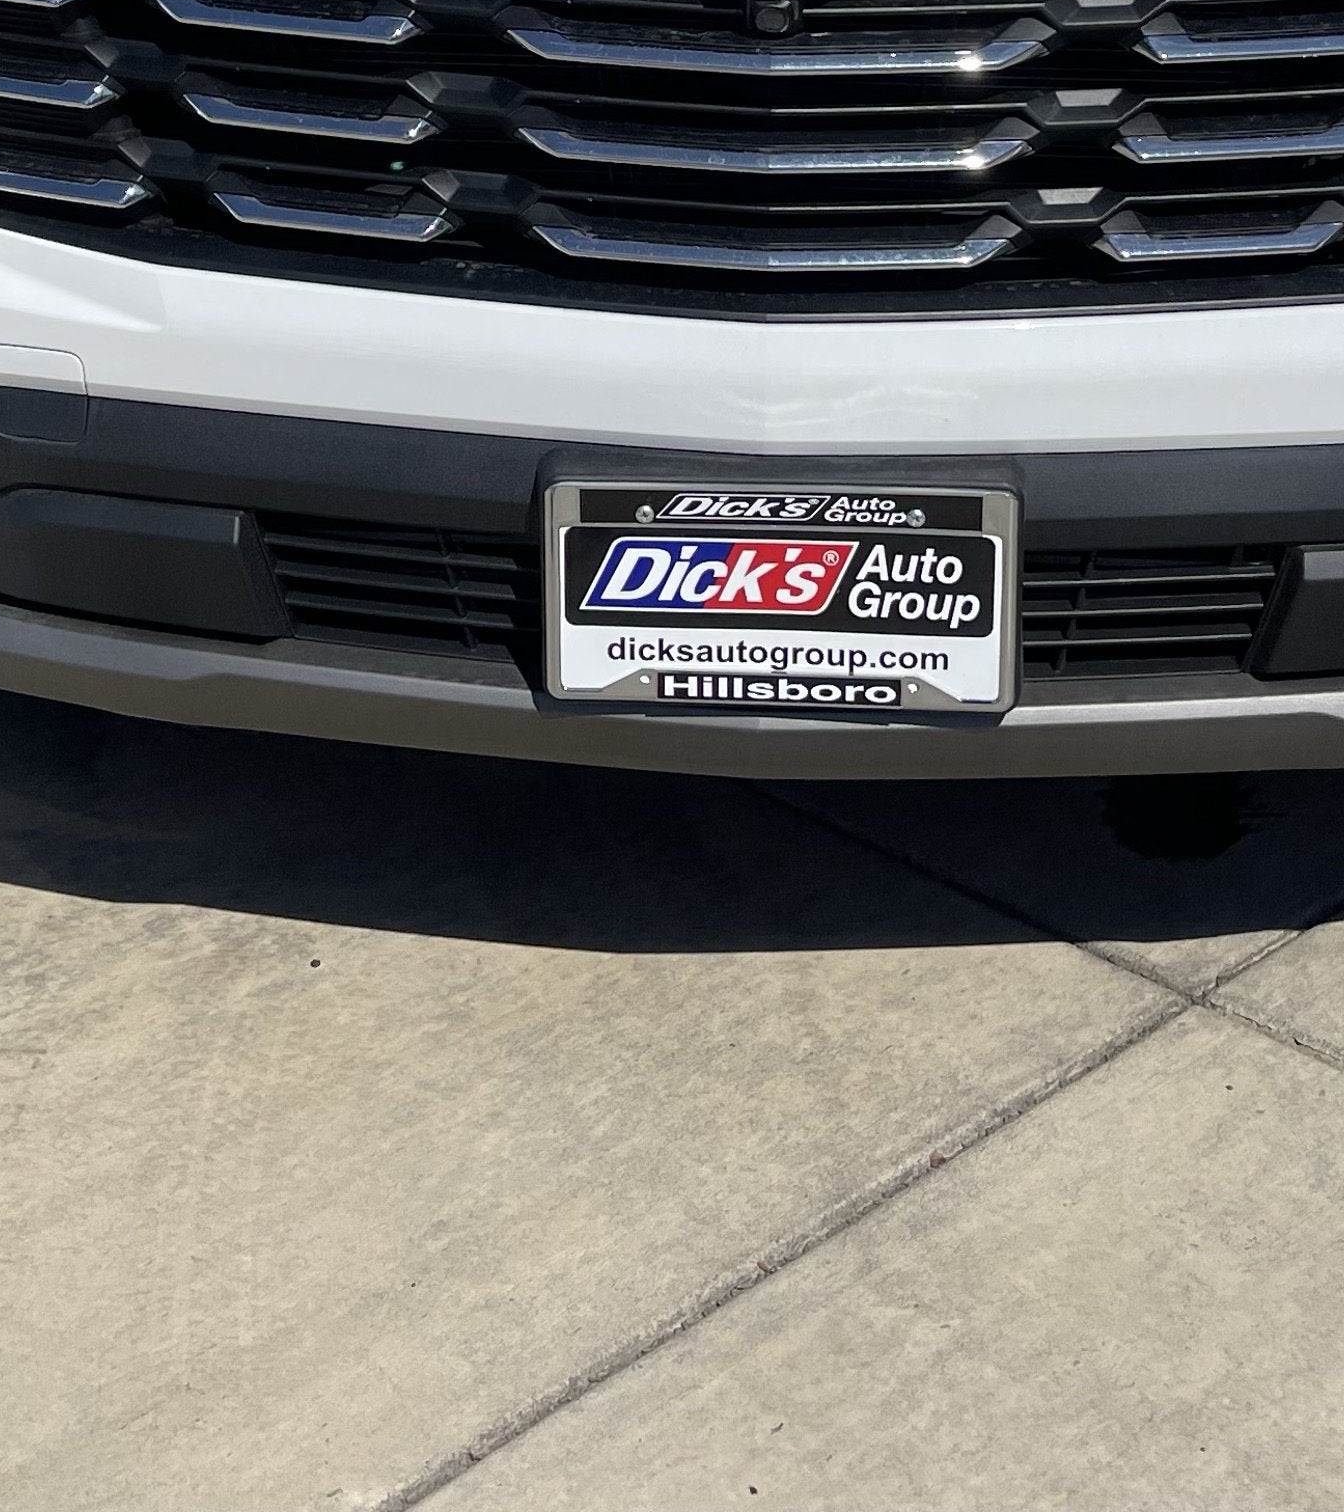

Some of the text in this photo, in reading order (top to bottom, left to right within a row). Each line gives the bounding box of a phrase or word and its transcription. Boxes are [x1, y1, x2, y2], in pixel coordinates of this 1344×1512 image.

[668, 495, 811, 518] Dick's
[823, 509, 907, 526] Group
[830, 496, 897, 511] Auto
[599, 544, 827, 605] Dick's
[855, 544, 964, 585] Auto
[847, 581, 982, 630] Group
[606, 637, 950, 675] dicksautogroup.com
[662, 675, 898, 704] Hillsboro
